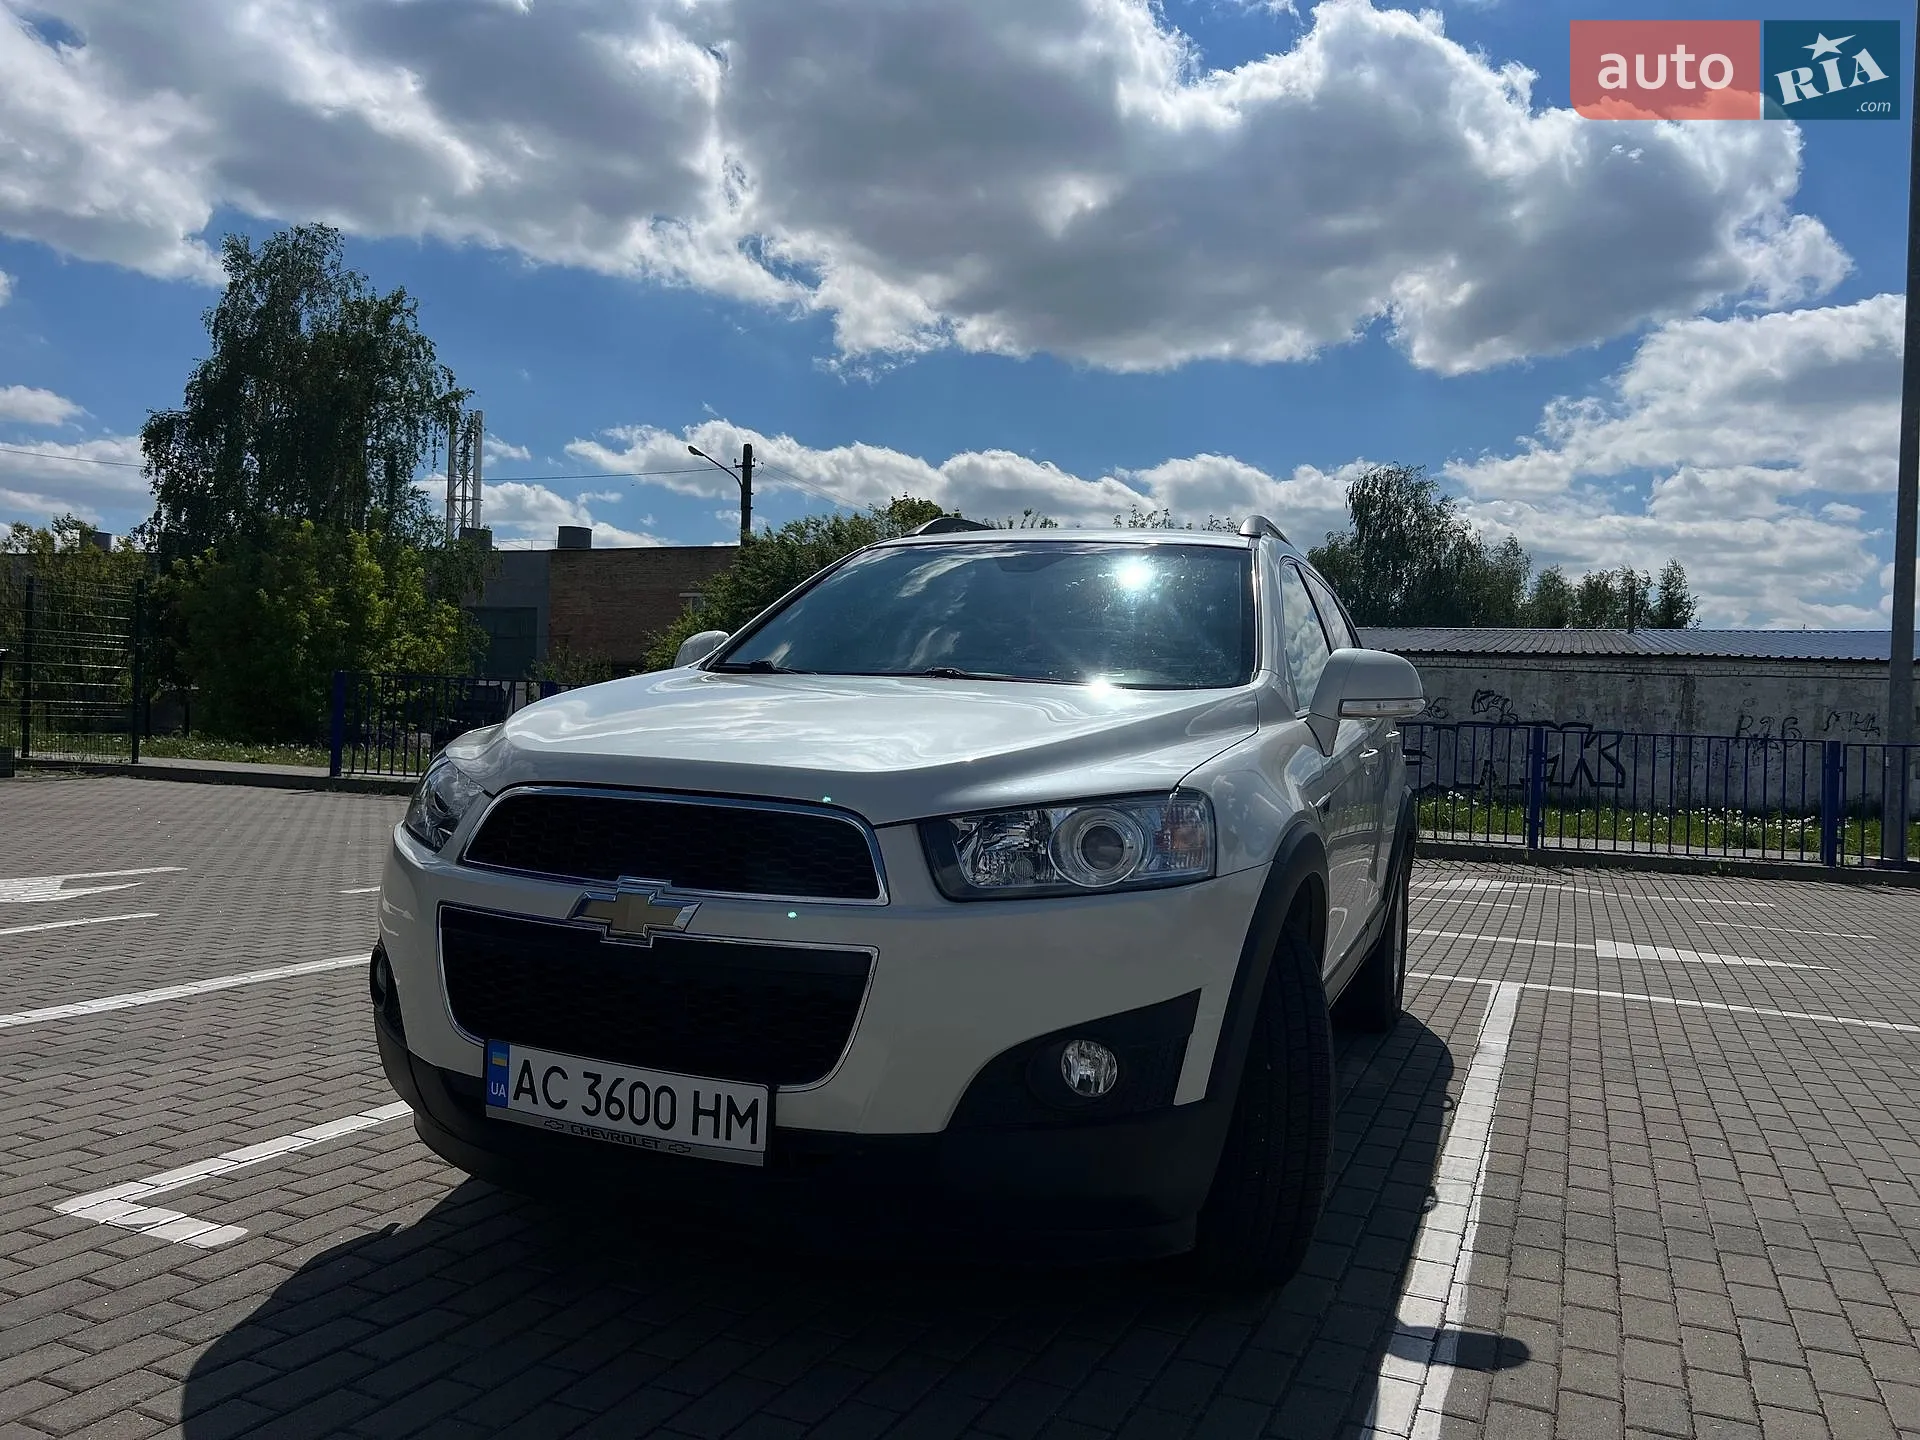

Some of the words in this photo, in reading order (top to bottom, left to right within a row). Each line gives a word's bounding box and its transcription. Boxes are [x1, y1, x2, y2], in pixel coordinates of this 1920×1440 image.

[491, 1082, 507, 1098] UA
[512, 1059, 569, 1110] AC
[581, 1071, 677, 1131] 3600
[691, 1090, 759, 1145] HM
[571, 1124, 661, 1150] CHEVROLET
